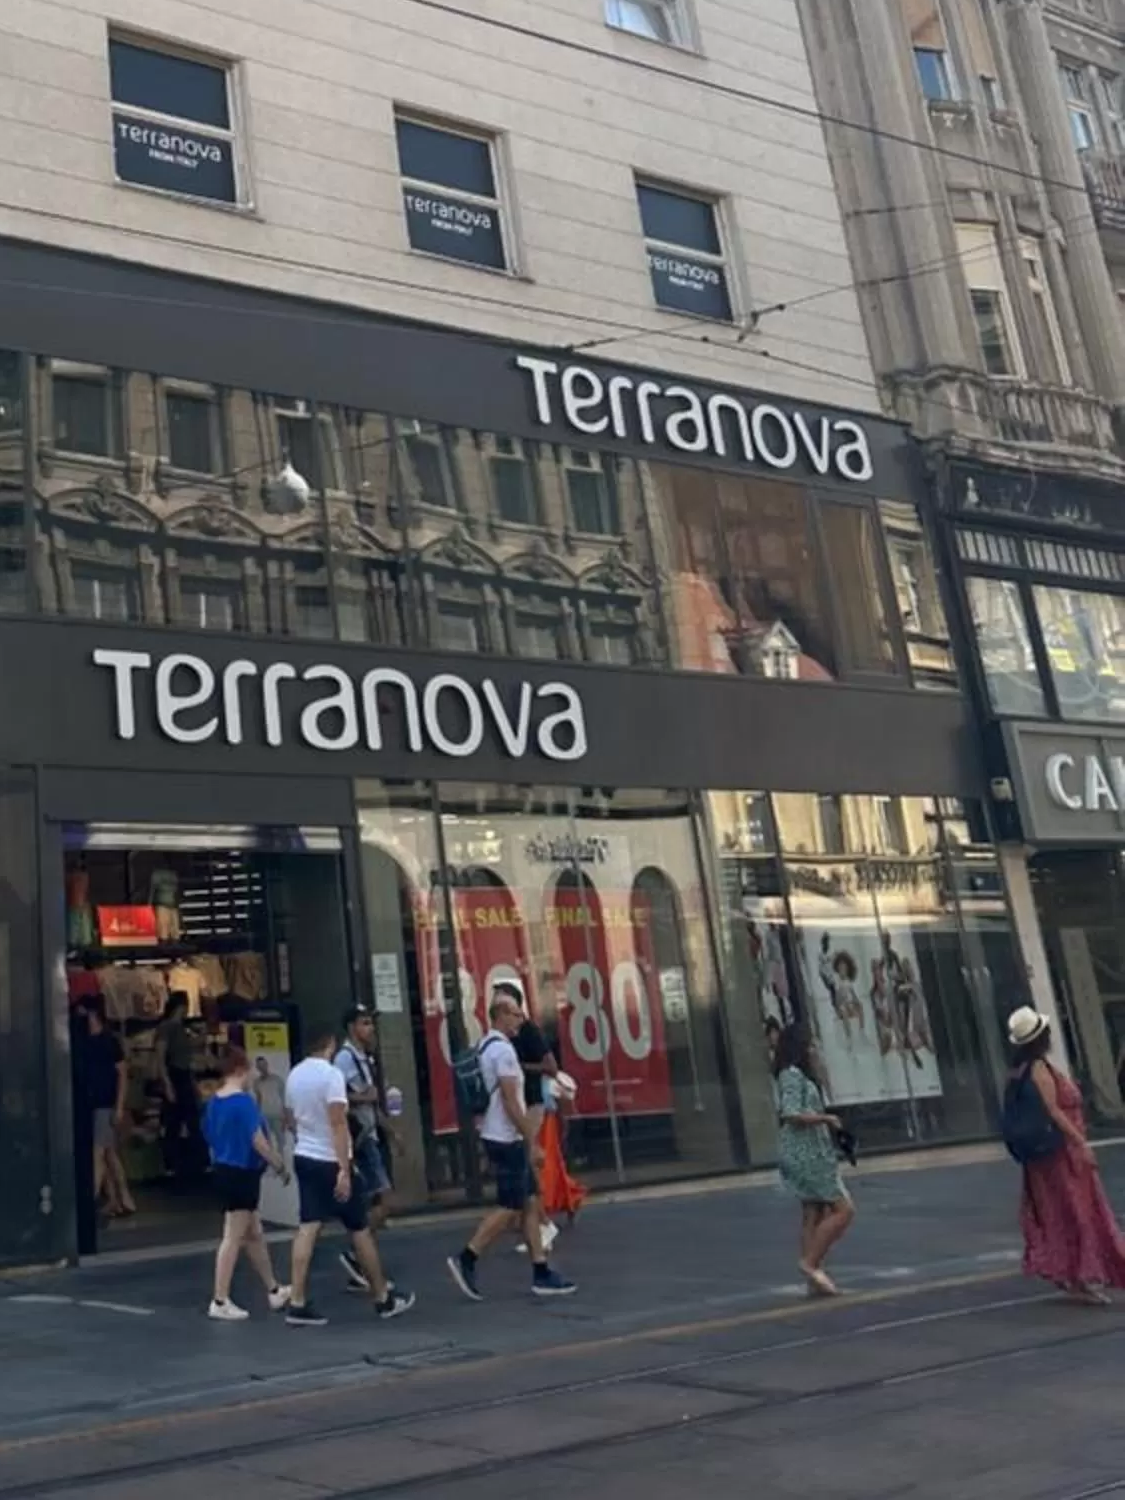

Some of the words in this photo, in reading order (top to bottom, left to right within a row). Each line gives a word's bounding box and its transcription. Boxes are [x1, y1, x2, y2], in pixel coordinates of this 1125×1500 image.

[118, 122, 222, 163] Terranova
[404, 195, 492, 230] Terranova
[516, 356, 873, 481] Terranova
[93, 648, 588, 761] Terranova
[1045, 752, 1125, 811] CA
[567, 961, 652, 1061] 80
